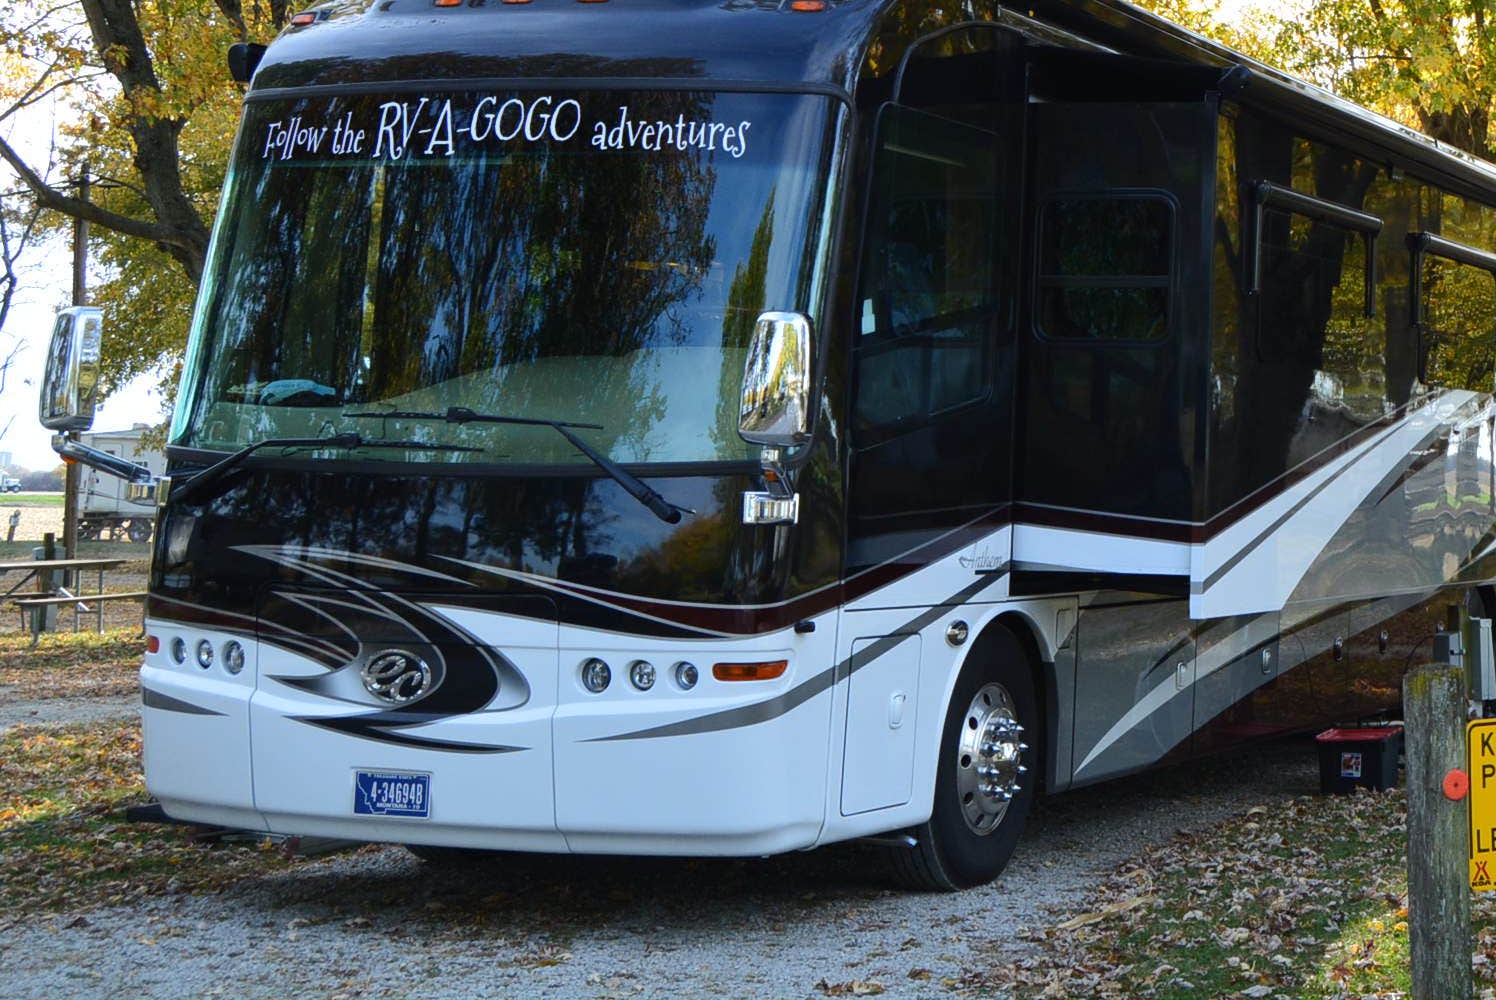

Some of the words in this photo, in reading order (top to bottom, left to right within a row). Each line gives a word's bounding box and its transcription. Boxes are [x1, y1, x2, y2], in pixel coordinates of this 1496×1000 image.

[262, 117, 328, 160] Follow
[332, 112, 365, 155] the
[372, 96, 580, 161] RV-A-GOGO
[591, 106, 751, 158] adventures
